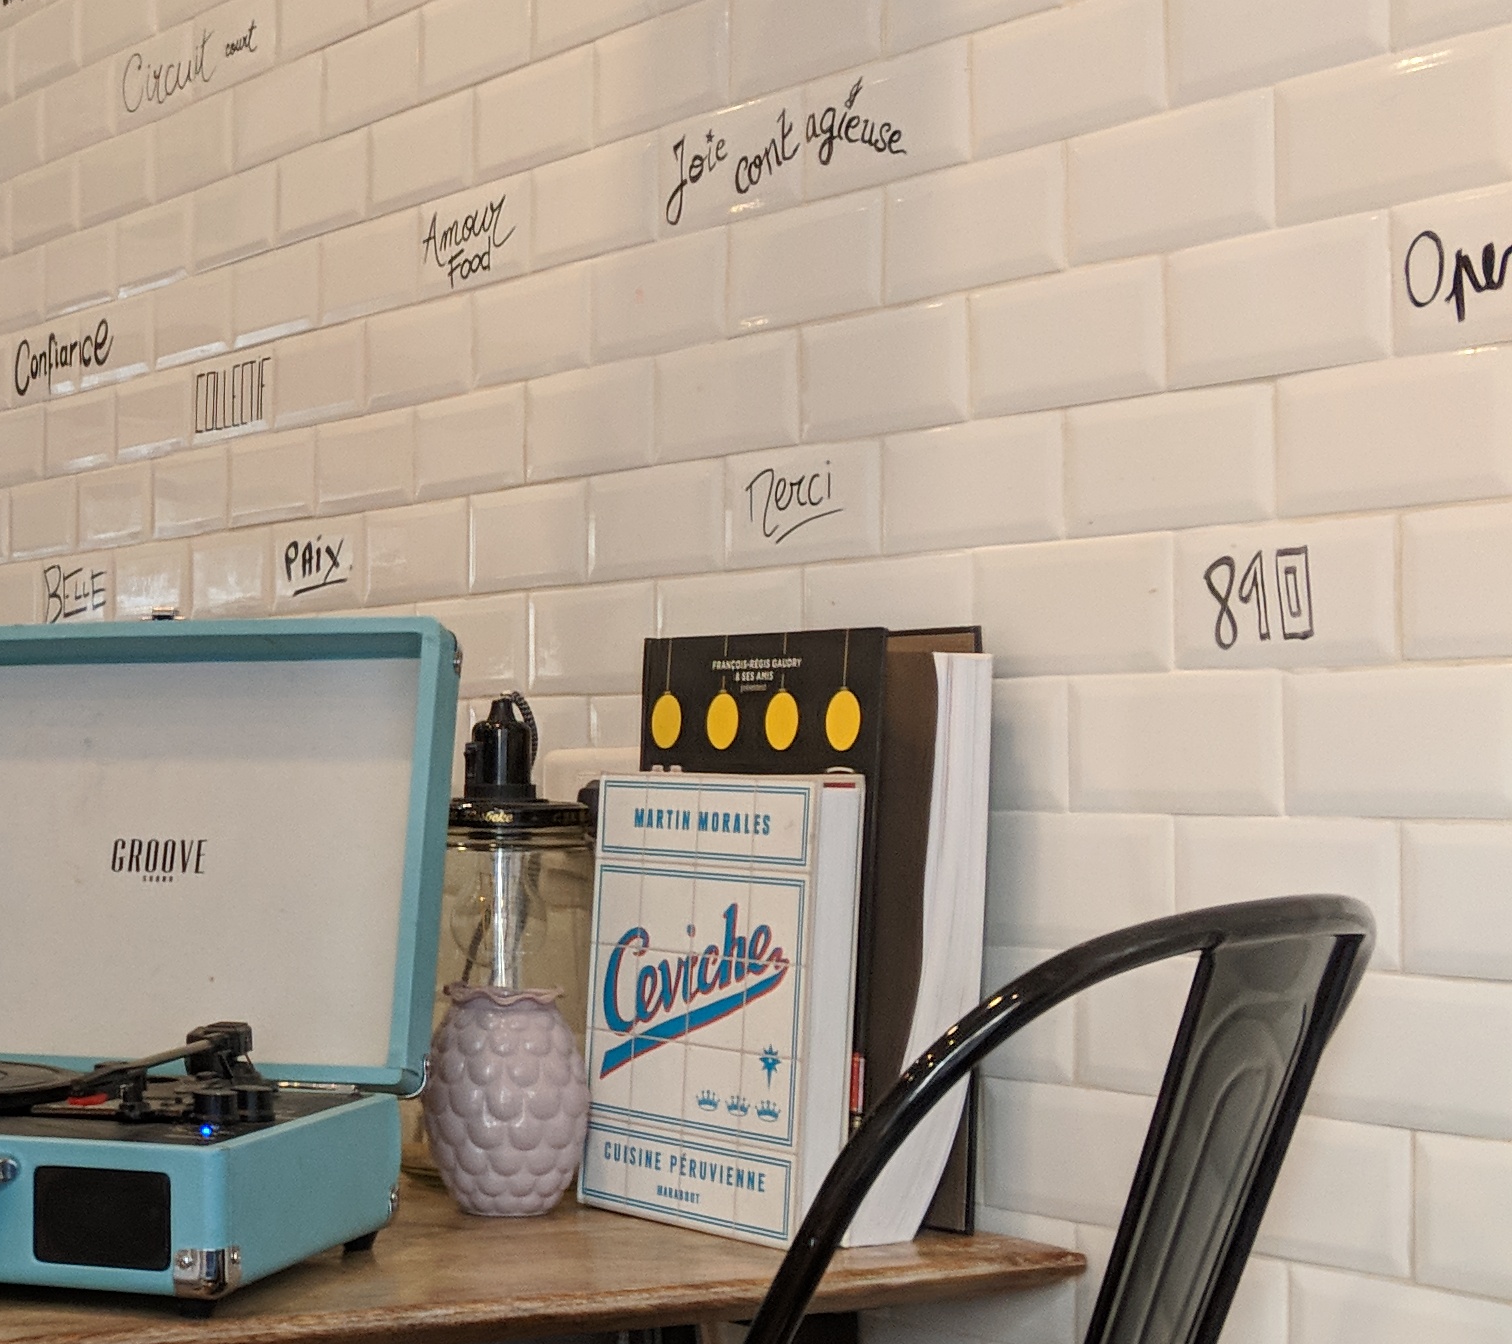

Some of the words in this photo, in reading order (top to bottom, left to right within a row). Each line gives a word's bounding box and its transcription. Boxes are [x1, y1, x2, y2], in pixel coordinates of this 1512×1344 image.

[122, 28, 217, 113] Circuit
[666, 129, 729, 226] Joie
[423, 193, 517, 268] Amour
[448, 234, 492, 289] Food
[14, 317, 114, 397] Confiance
[44, 564, 107, 624] BELLE
[634, 808, 691, 830] MARTIN
[697, 811, 771, 835] MORALES
[111, 838, 207, 874] GROOVE
[603, 902, 790, 1037] Ceviche
[604, 1141, 661, 1171] CUISINE
[670, 1153, 767, 1192] PÉRUVIENNE
